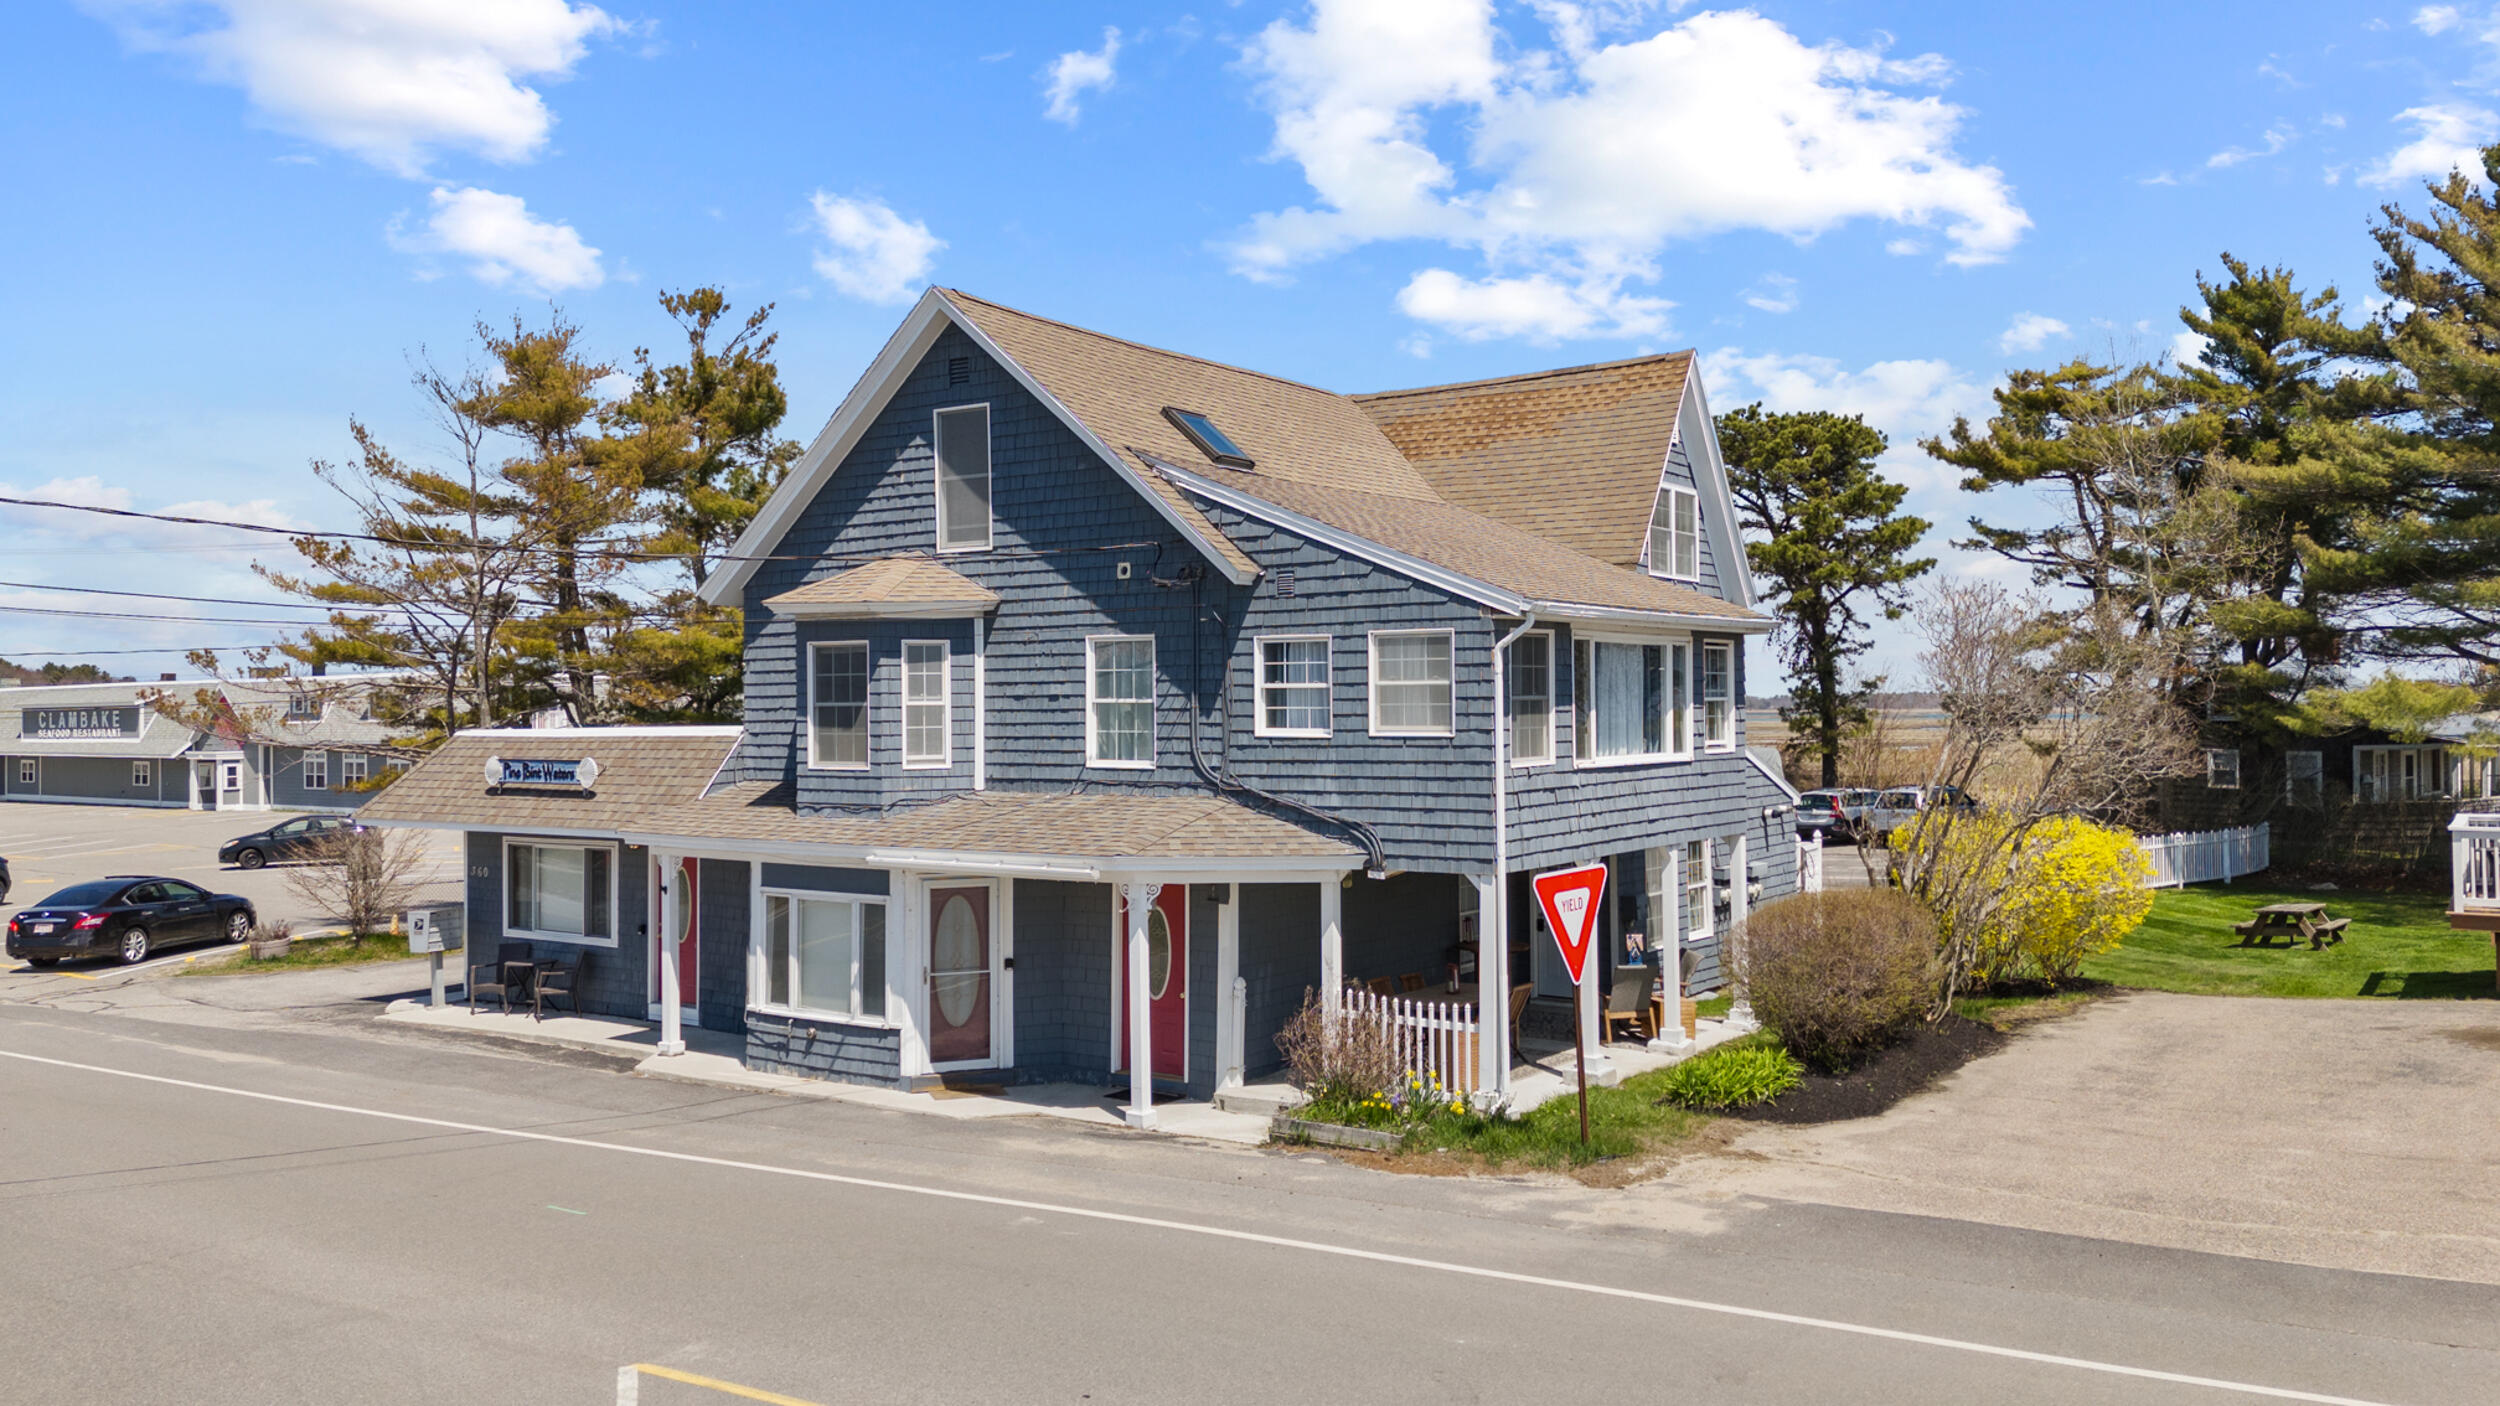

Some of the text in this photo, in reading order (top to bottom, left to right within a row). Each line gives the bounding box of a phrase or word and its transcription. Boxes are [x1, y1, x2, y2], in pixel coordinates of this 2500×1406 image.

[38, 710, 120, 729] CLAMBAKE
[37, 728, 121, 738] SEAFOOD RESTAURANT
[1561, 897, 1583, 912] YIELD
